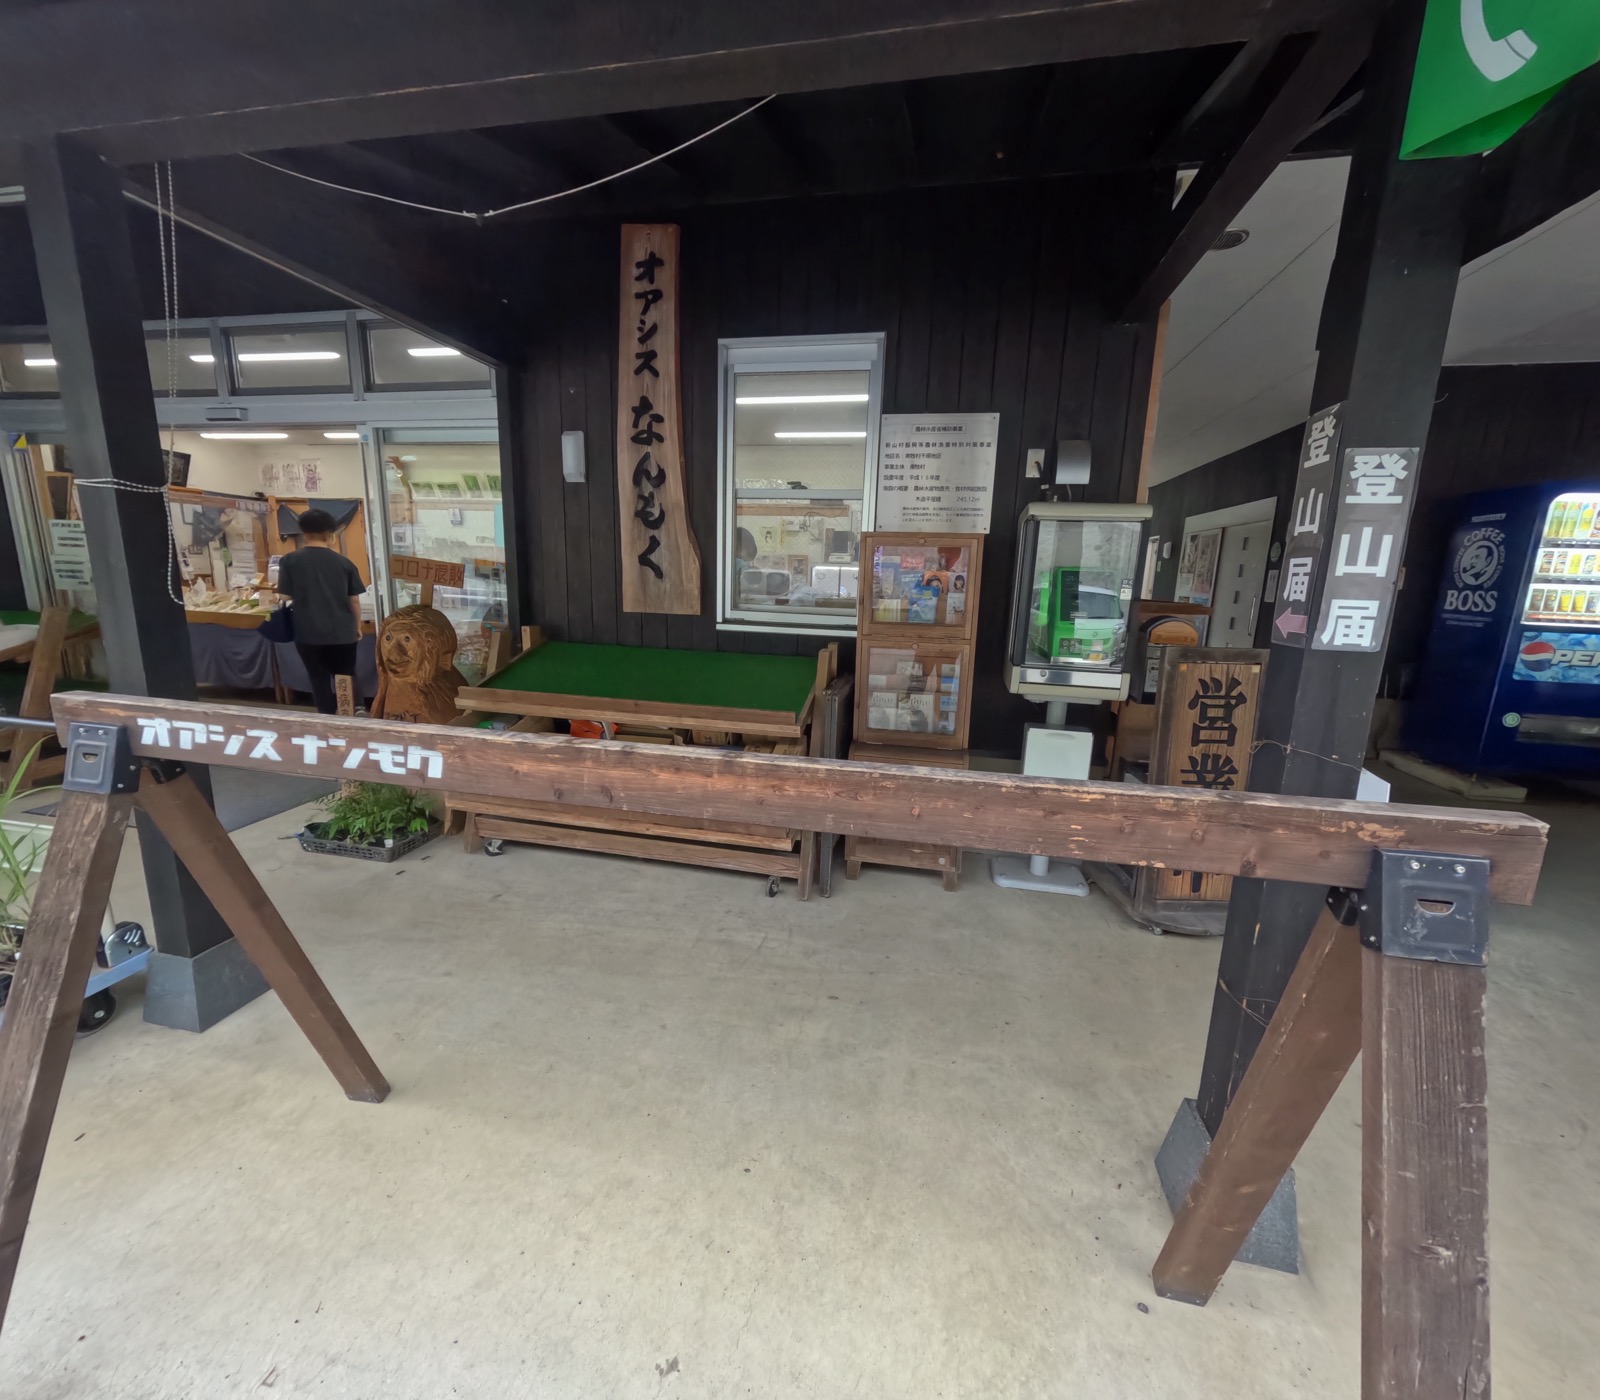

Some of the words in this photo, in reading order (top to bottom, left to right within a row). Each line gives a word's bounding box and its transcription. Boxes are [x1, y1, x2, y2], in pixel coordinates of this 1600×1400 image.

[634, 251, 665, 378] オアシス
[630, 395, 667, 579] なんもく
[1283, 415, 1337, 603] 登山届
[393, 558, 464, 586] コロナ退散
[1320, 453, 1409, 647] 登山届
[1464, 527, 1506, 545] COFFEE
[1443, 590, 1499, 613] BOSS
[137, 718, 282, 761] オアシス
[291, 735, 443, 778] ナンモク
